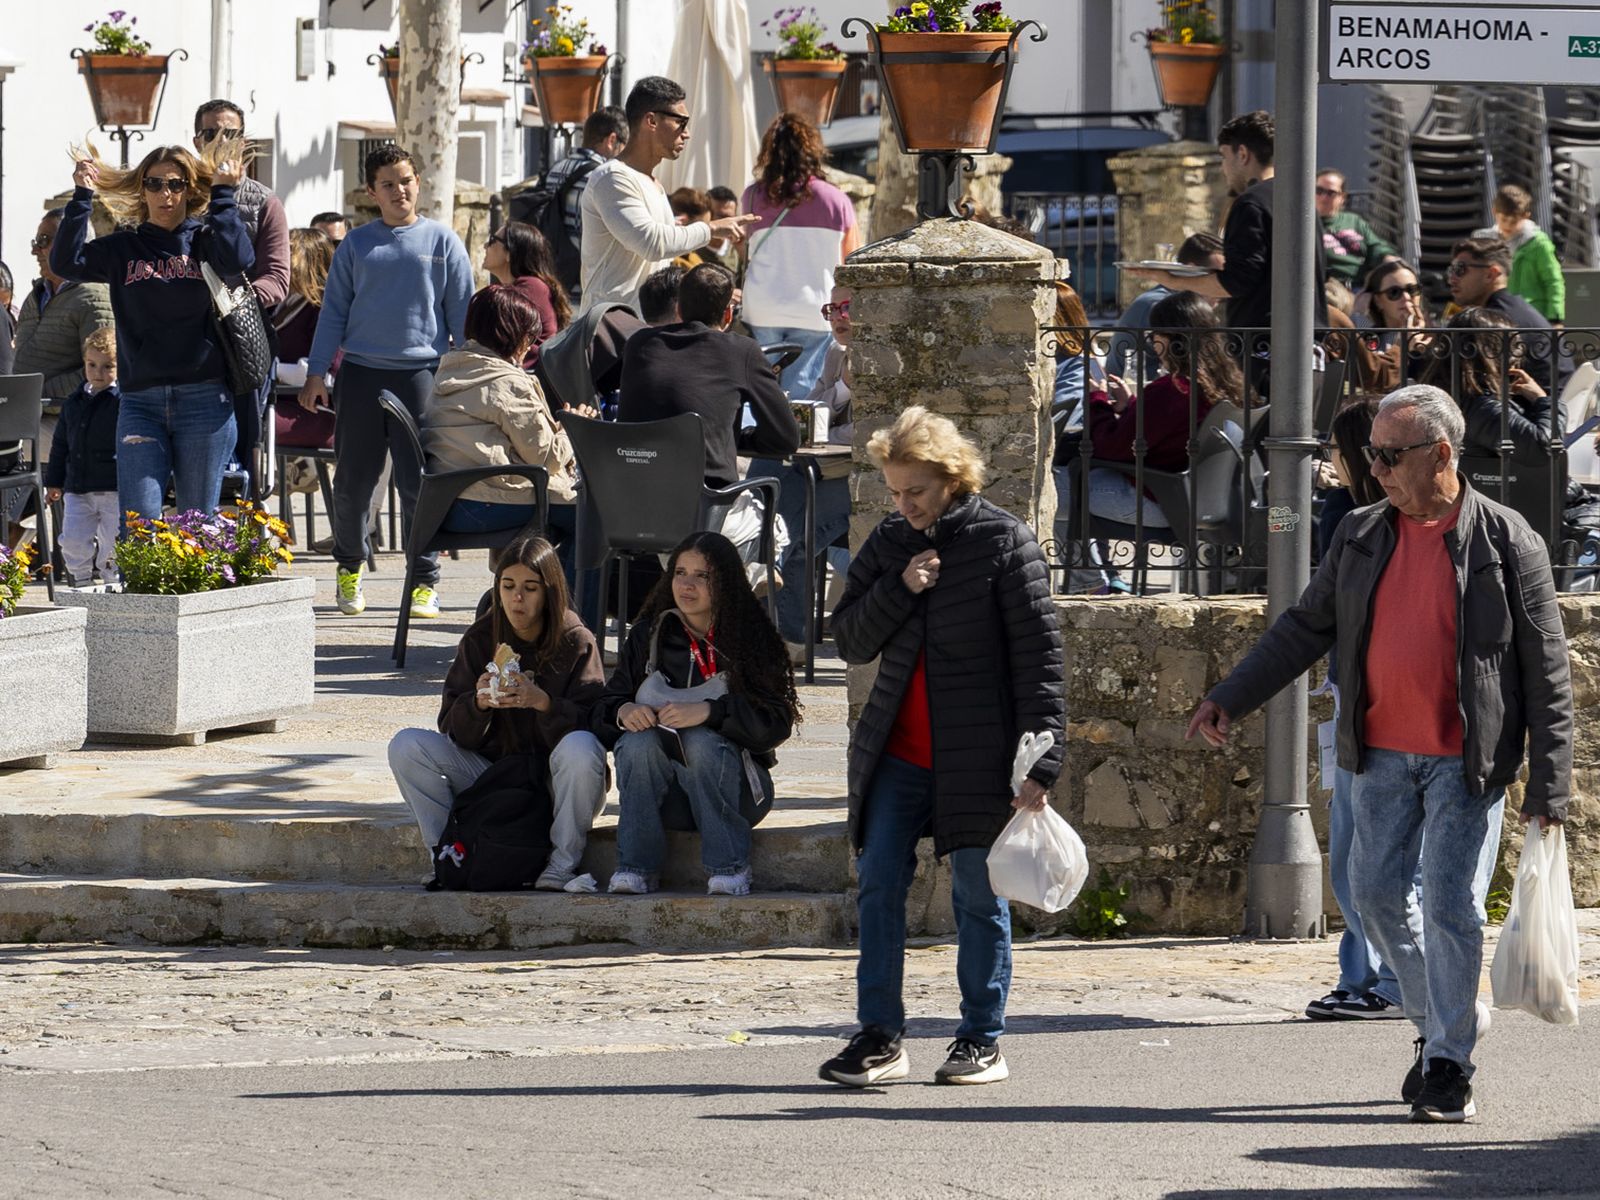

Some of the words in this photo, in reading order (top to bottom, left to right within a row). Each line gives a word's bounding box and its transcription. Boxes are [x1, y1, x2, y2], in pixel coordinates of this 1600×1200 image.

[1338, 16, 1533, 41] BENAMAHOMA
[1336, 47, 1431, 70] ARCOS
[124, 259, 155, 285] LOS
[157, 255, 204, 280] ANGEL
[617, 447, 657, 458] Cruzcampo
